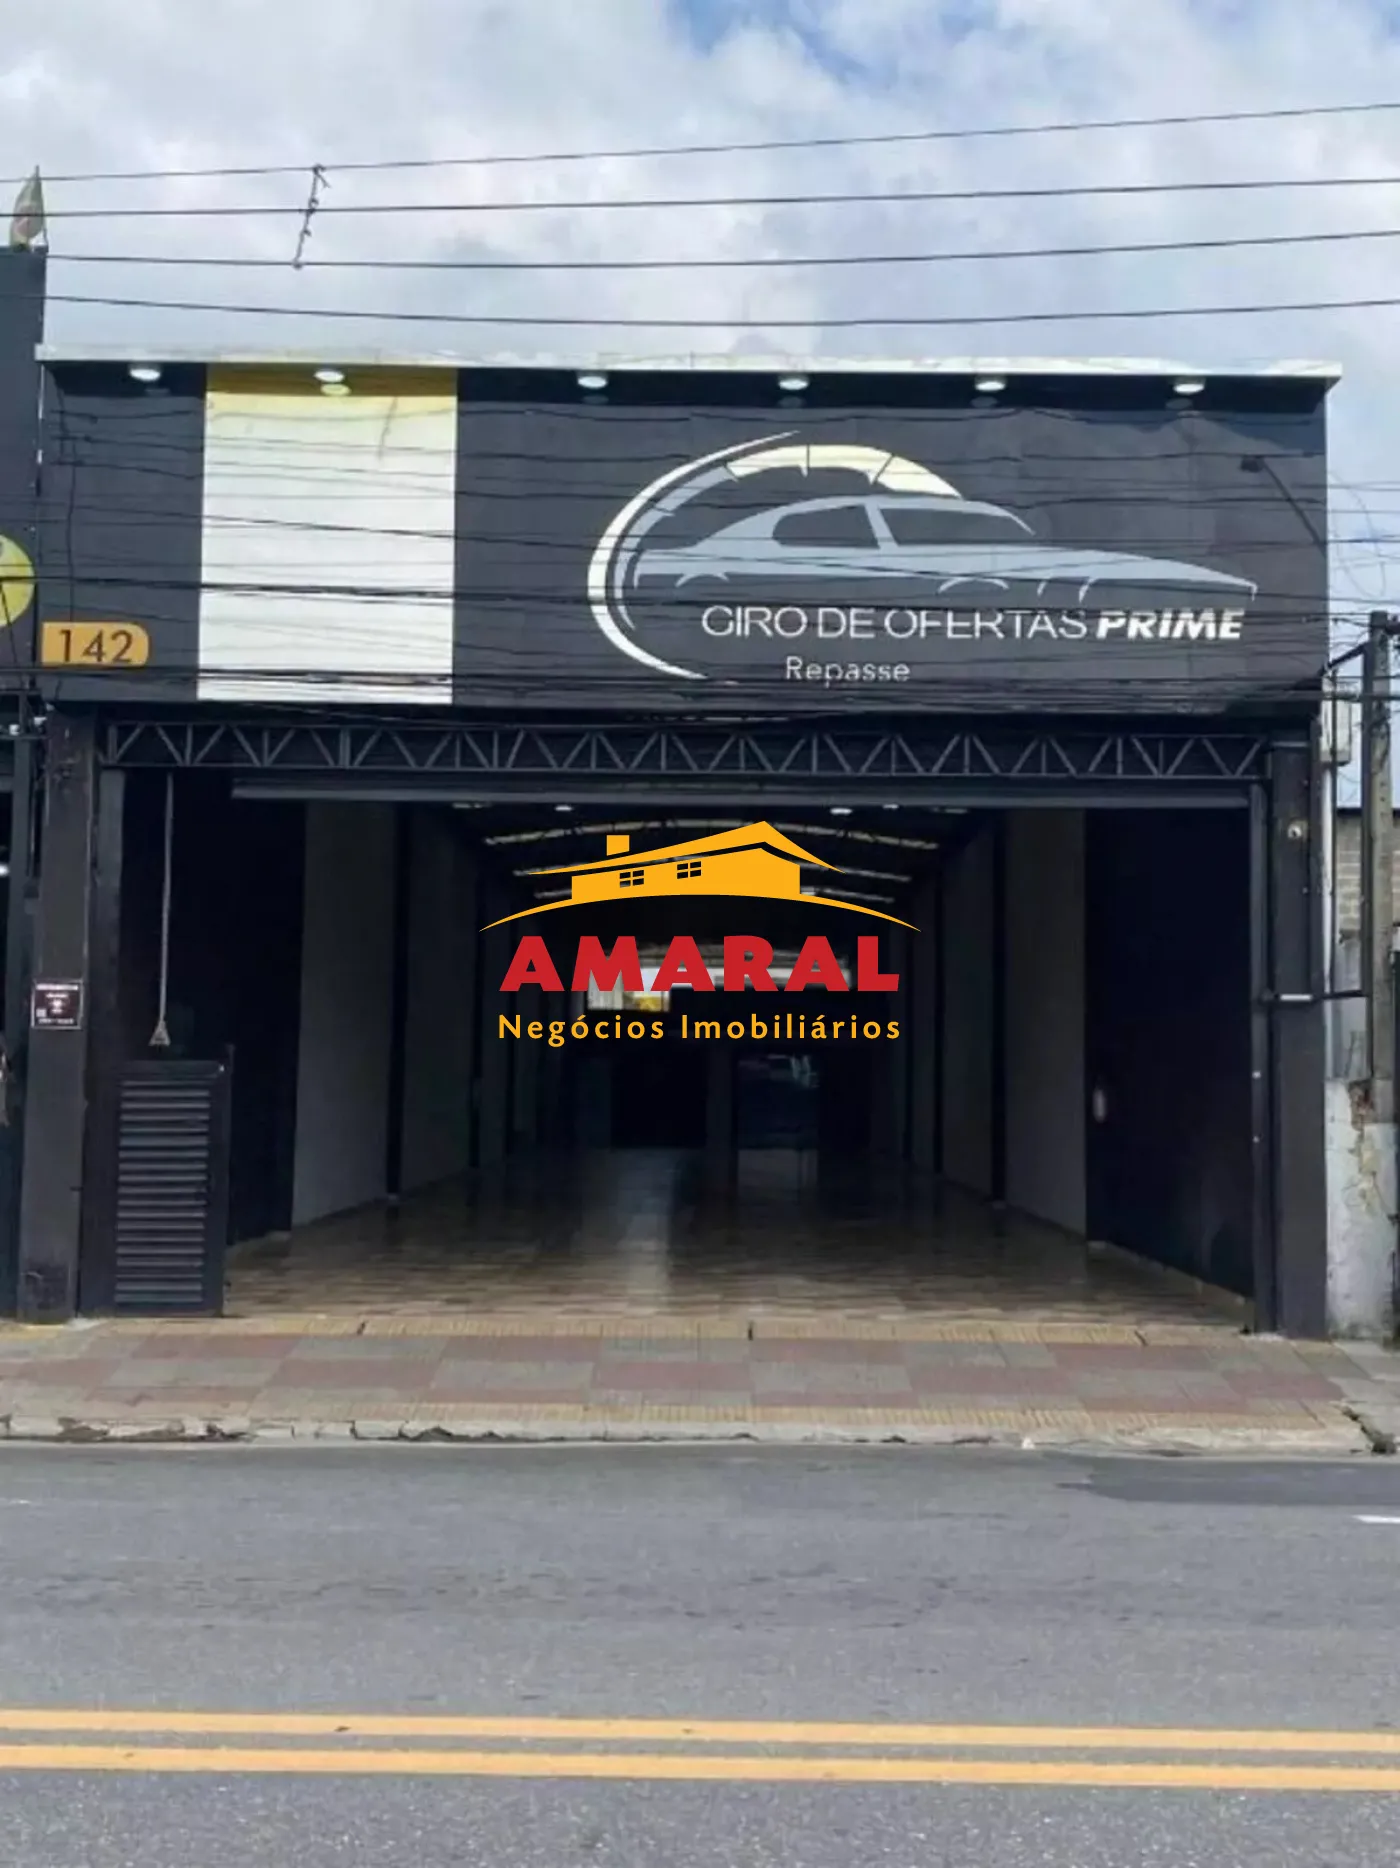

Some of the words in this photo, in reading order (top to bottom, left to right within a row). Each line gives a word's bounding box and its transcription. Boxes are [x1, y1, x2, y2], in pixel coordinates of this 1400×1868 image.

[702, 605, 808, 637] GIRO
[817, 607, 876, 638] DE
[884, 608, 1088, 639] OFERTAS
[1095, 607, 1246, 640] PRIME
[59, 629, 133, 662] 142
[786, 655, 911, 689] Repasse
